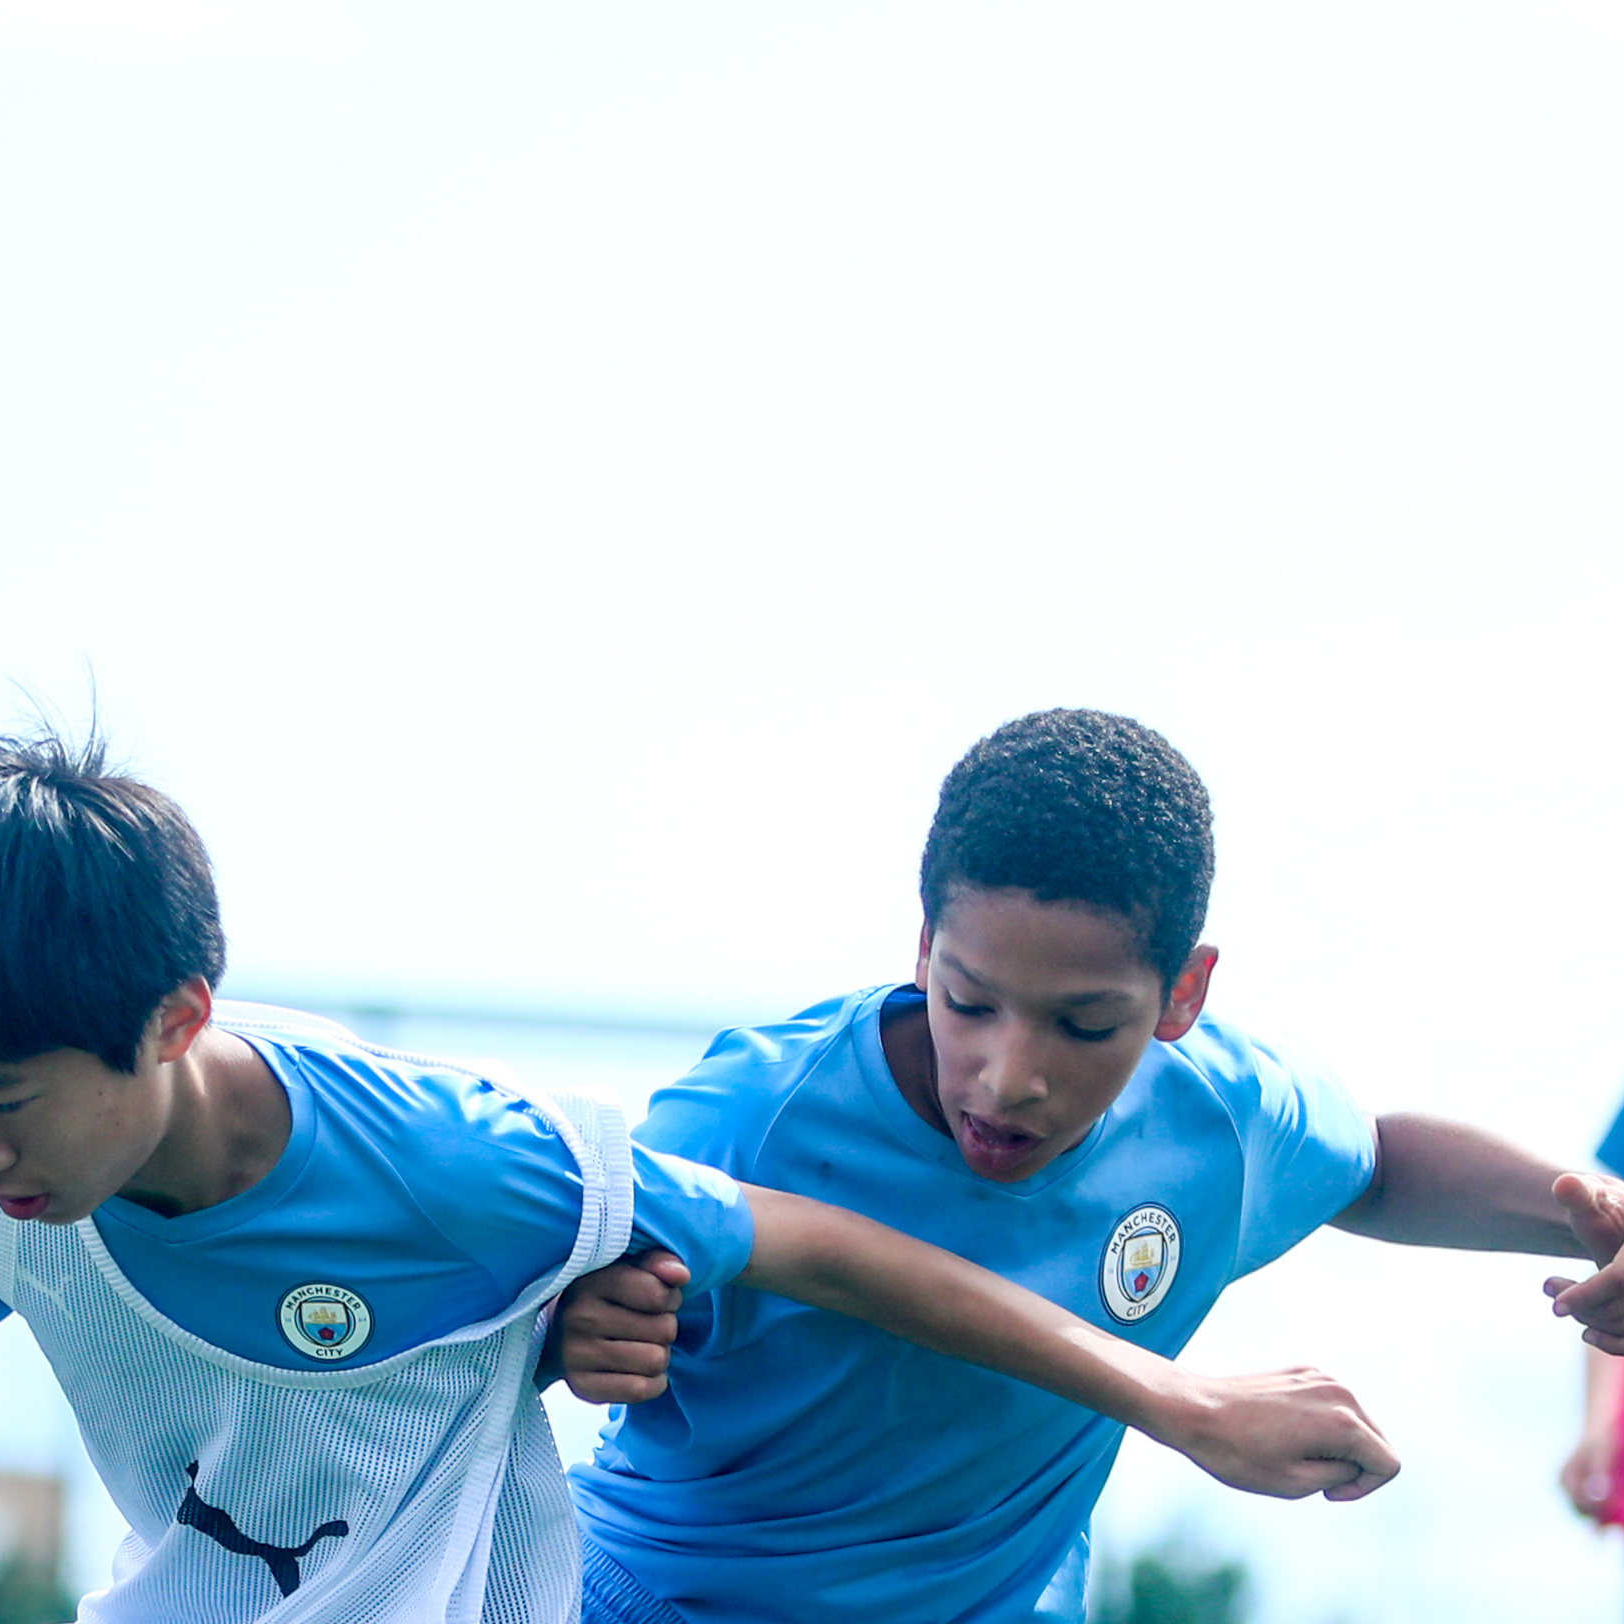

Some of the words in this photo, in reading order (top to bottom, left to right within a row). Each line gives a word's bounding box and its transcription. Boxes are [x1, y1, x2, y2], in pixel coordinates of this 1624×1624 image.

[1111, 1212, 1177, 1255] MANCHESTER
[286, 1287, 361, 1311] MANCHESTER
[1127, 1303, 1149, 1317] CITY
[316, 1349, 343, 1357] CITY
